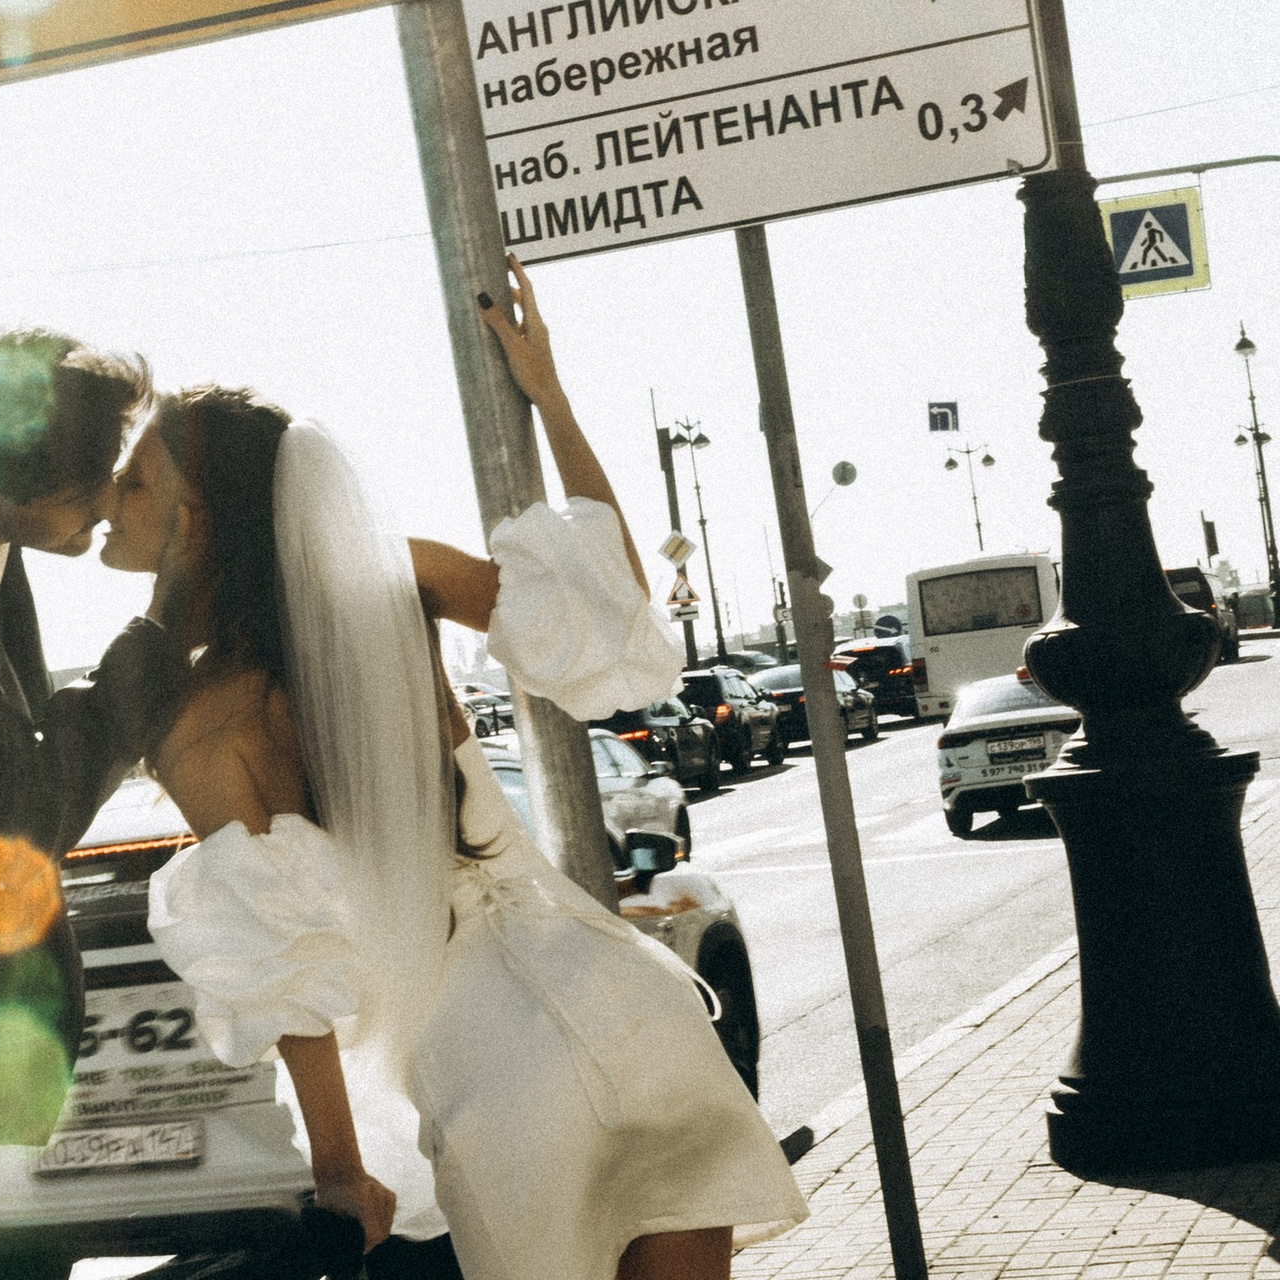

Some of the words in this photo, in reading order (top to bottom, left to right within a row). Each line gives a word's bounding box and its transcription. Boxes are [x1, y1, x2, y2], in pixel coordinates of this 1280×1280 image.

[483, 24, 760, 109] набережная
[495, 143, 581, 190] наб.
[595, 74, 905, 171] ЛЕЙТЕНАНТА
[919, 92, 988, 145] 0,3
[501, 175, 704, 247] ШМИДТА
